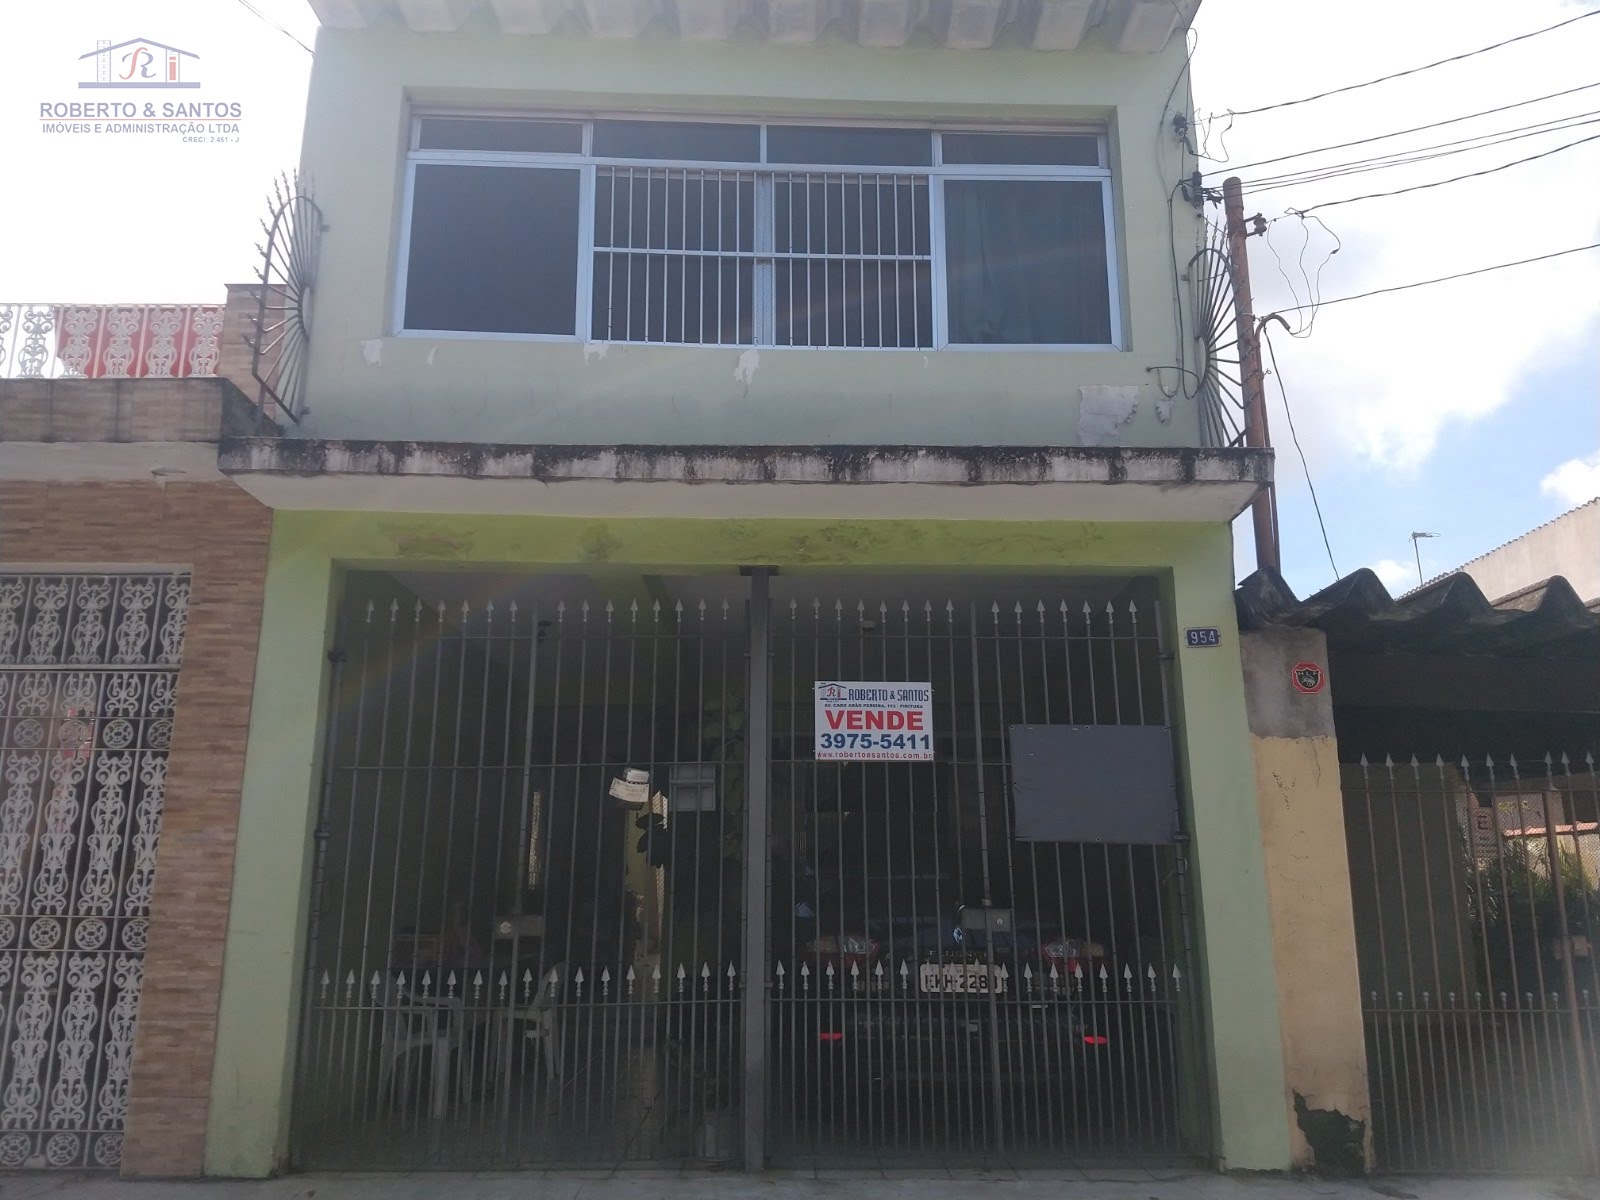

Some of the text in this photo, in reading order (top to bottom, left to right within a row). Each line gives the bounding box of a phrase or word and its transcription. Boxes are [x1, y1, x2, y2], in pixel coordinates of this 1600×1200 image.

[1190, 631, 1216, 644] 954
[848, 688, 929, 702] ROBERTO & SANTOS
[825, 709, 924, 731] VENDE
[820, 733, 930, 750] 3975-5411
